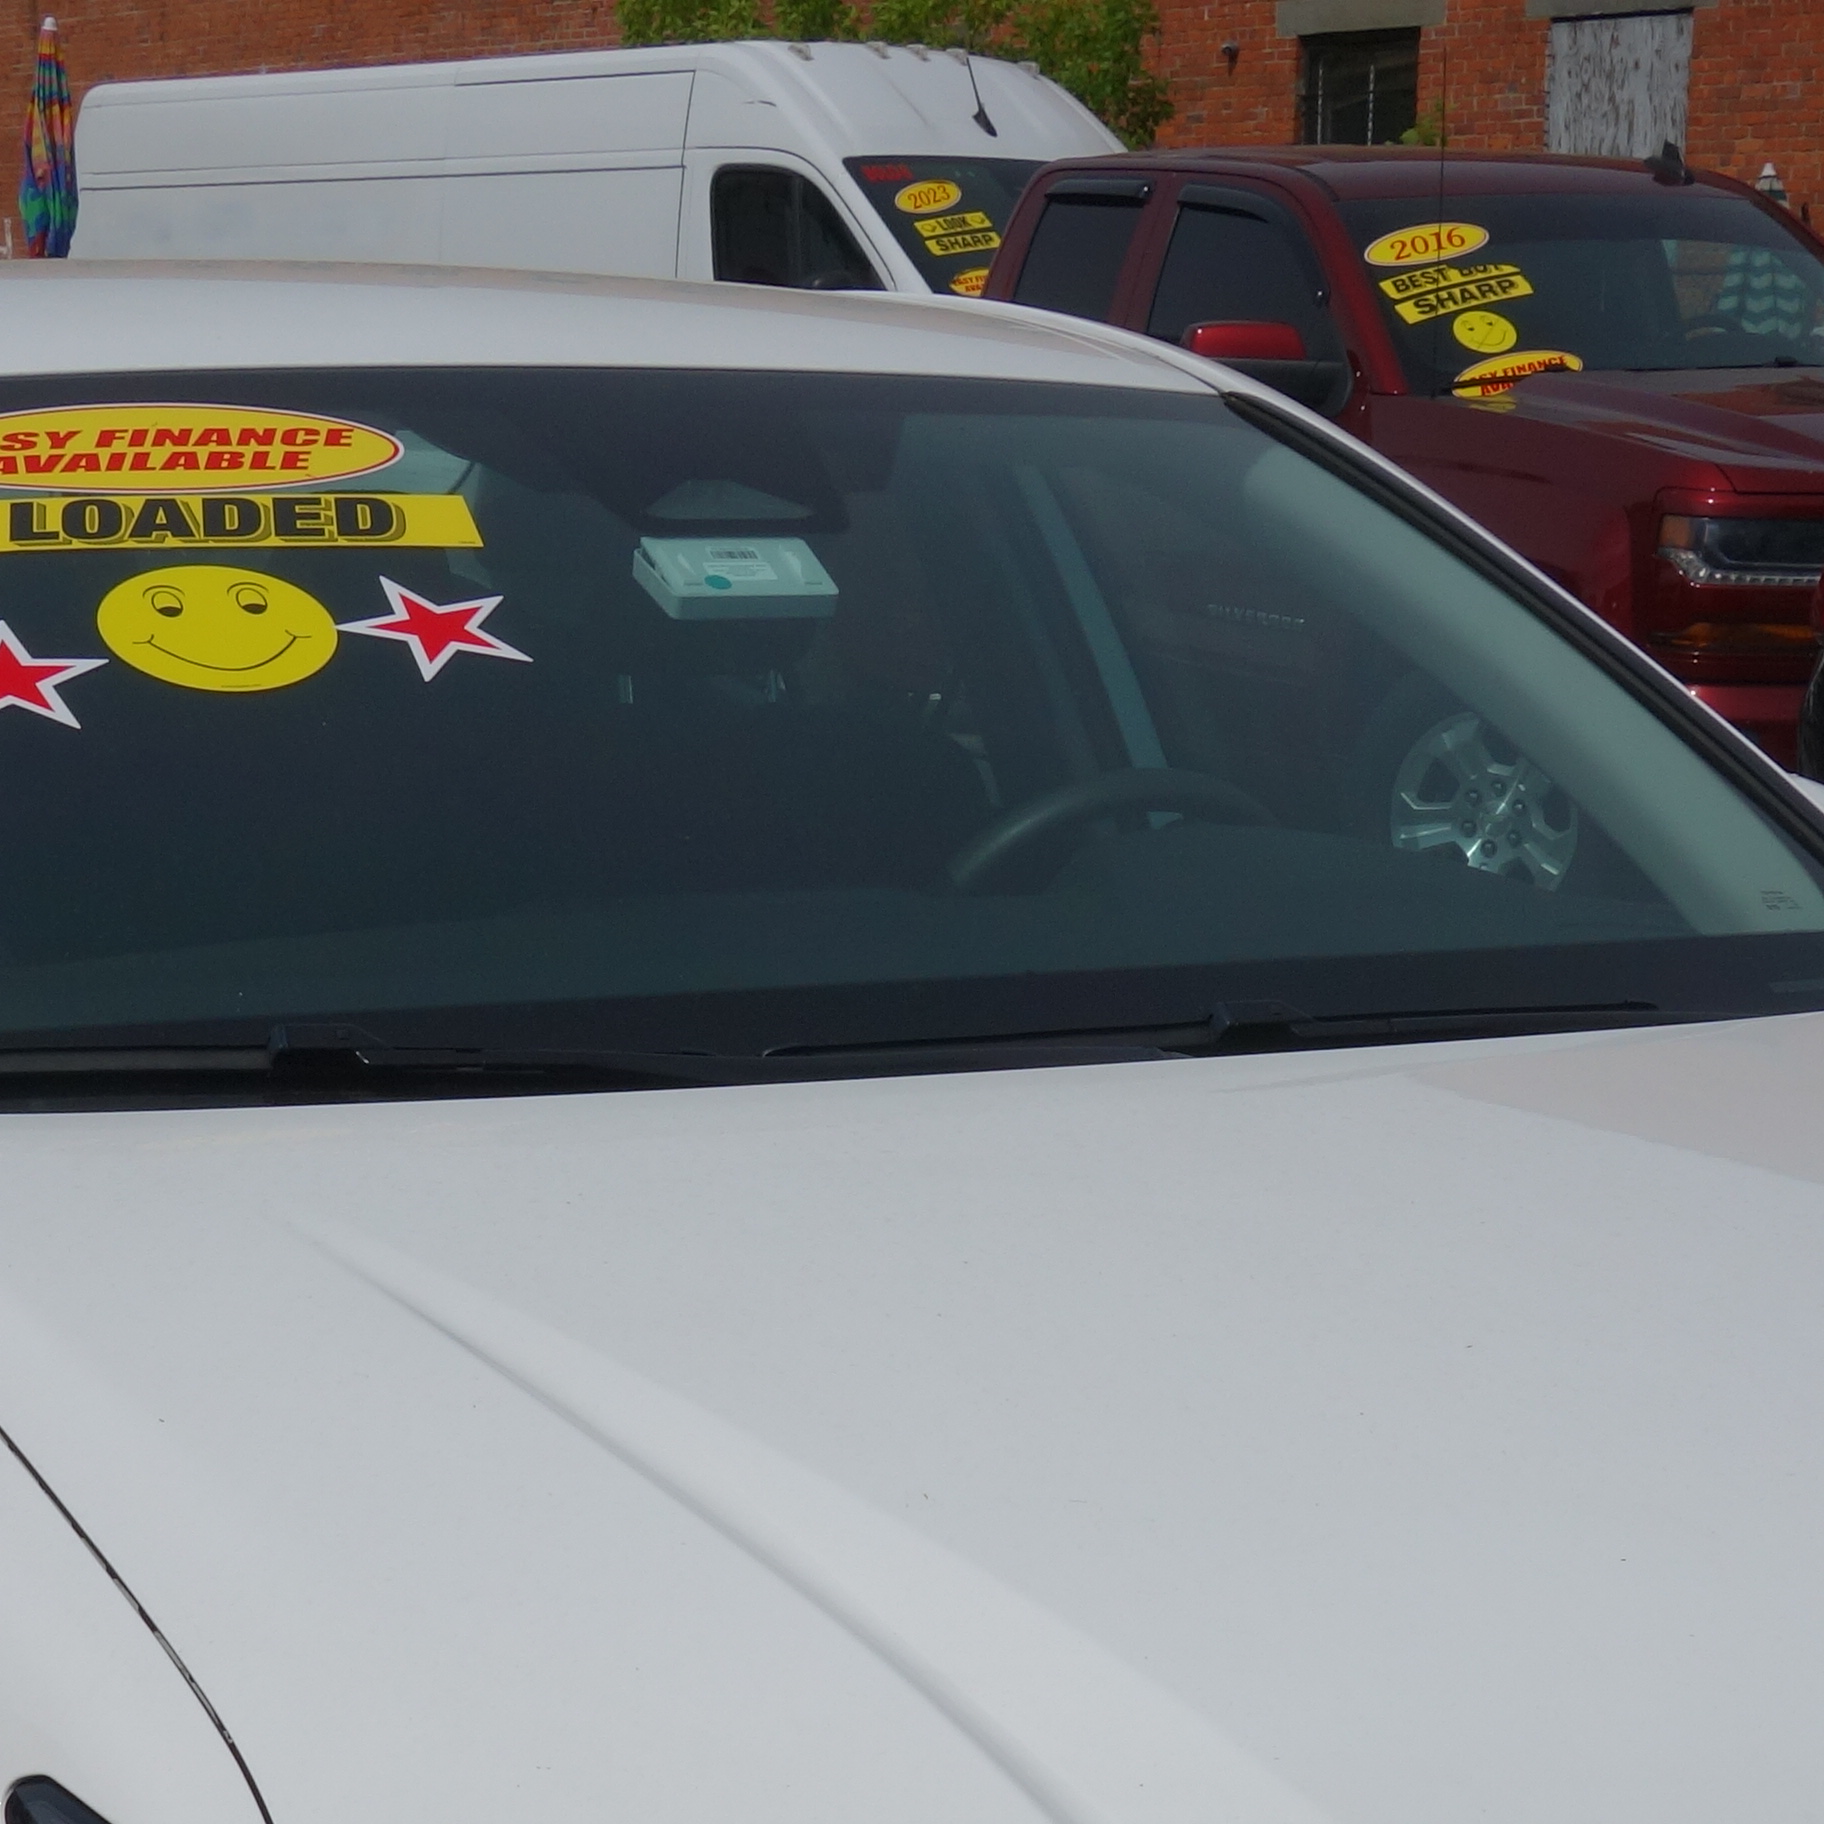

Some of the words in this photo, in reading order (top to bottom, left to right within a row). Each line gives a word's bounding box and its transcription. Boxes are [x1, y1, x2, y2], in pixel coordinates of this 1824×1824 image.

[907, 184, 951, 210] 2023
[935, 215, 973, 231] LOOK
[936, 235, 995, 251] SHARP
[1389, 226, 1466, 261] 2016
[1391, 266, 1451, 294] BEST
[1413, 278, 1518, 315] SHARP
[94, 427, 355, 449] FINANCE
[8, 497, 406, 545] LOADED
